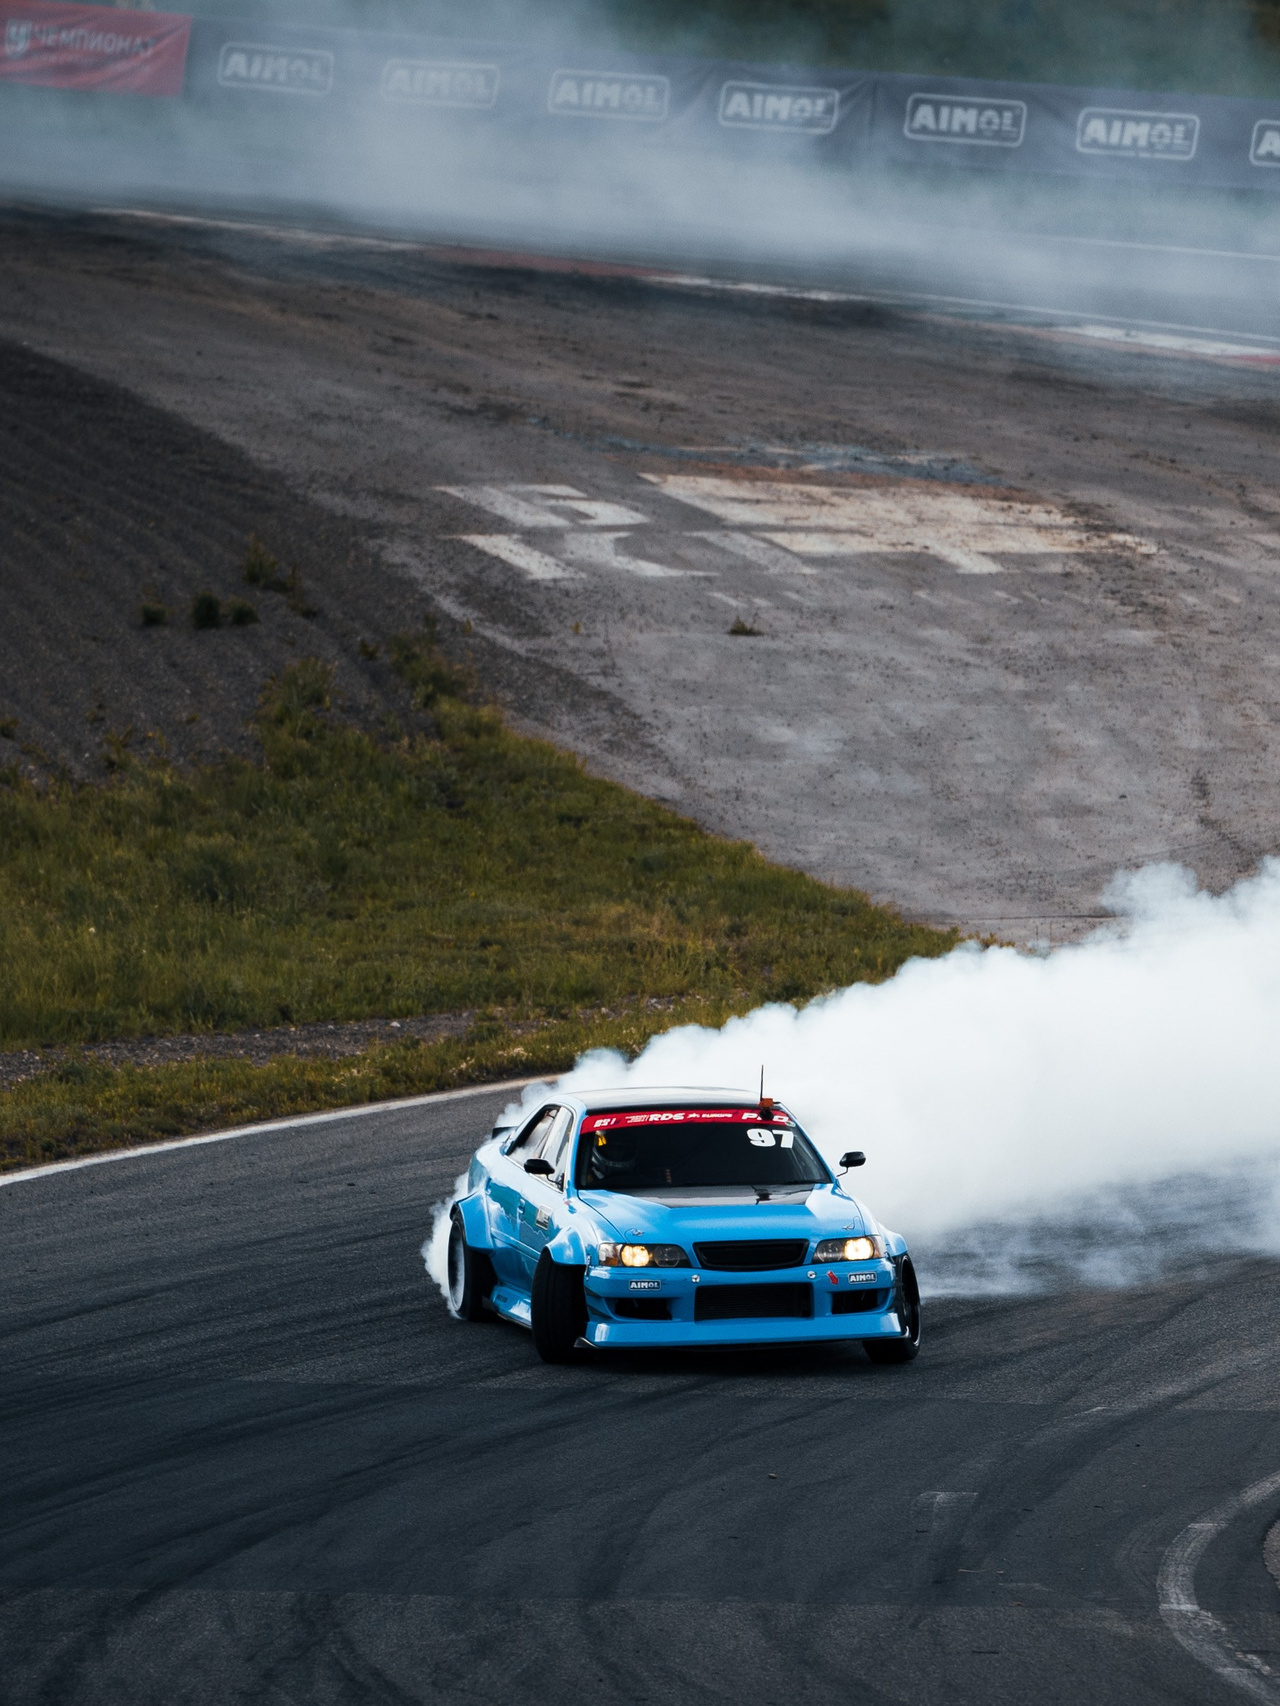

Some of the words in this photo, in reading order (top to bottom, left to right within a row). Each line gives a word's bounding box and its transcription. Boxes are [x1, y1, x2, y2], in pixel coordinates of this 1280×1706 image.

[34, 27, 155, 57] ЧЕМПИОНАТ
[223, 51, 331, 83] AIMOL
[387, 69, 492, 98] AIMOL
[555, 80, 659, 109] AIMOL
[723, 91, 828, 121] AIMOL
[911, 104, 1018, 134] AIMOL
[1083, 119, 1190, 149] AIMOL
[648, 1113, 685, 1122] RDS
[741, 1112, 789, 1122] PO
[746, 1128, 794, 1149] 97
[630, 1281, 660, 1289] AIMOL
[850, 1273, 876, 1282] AIMOL
